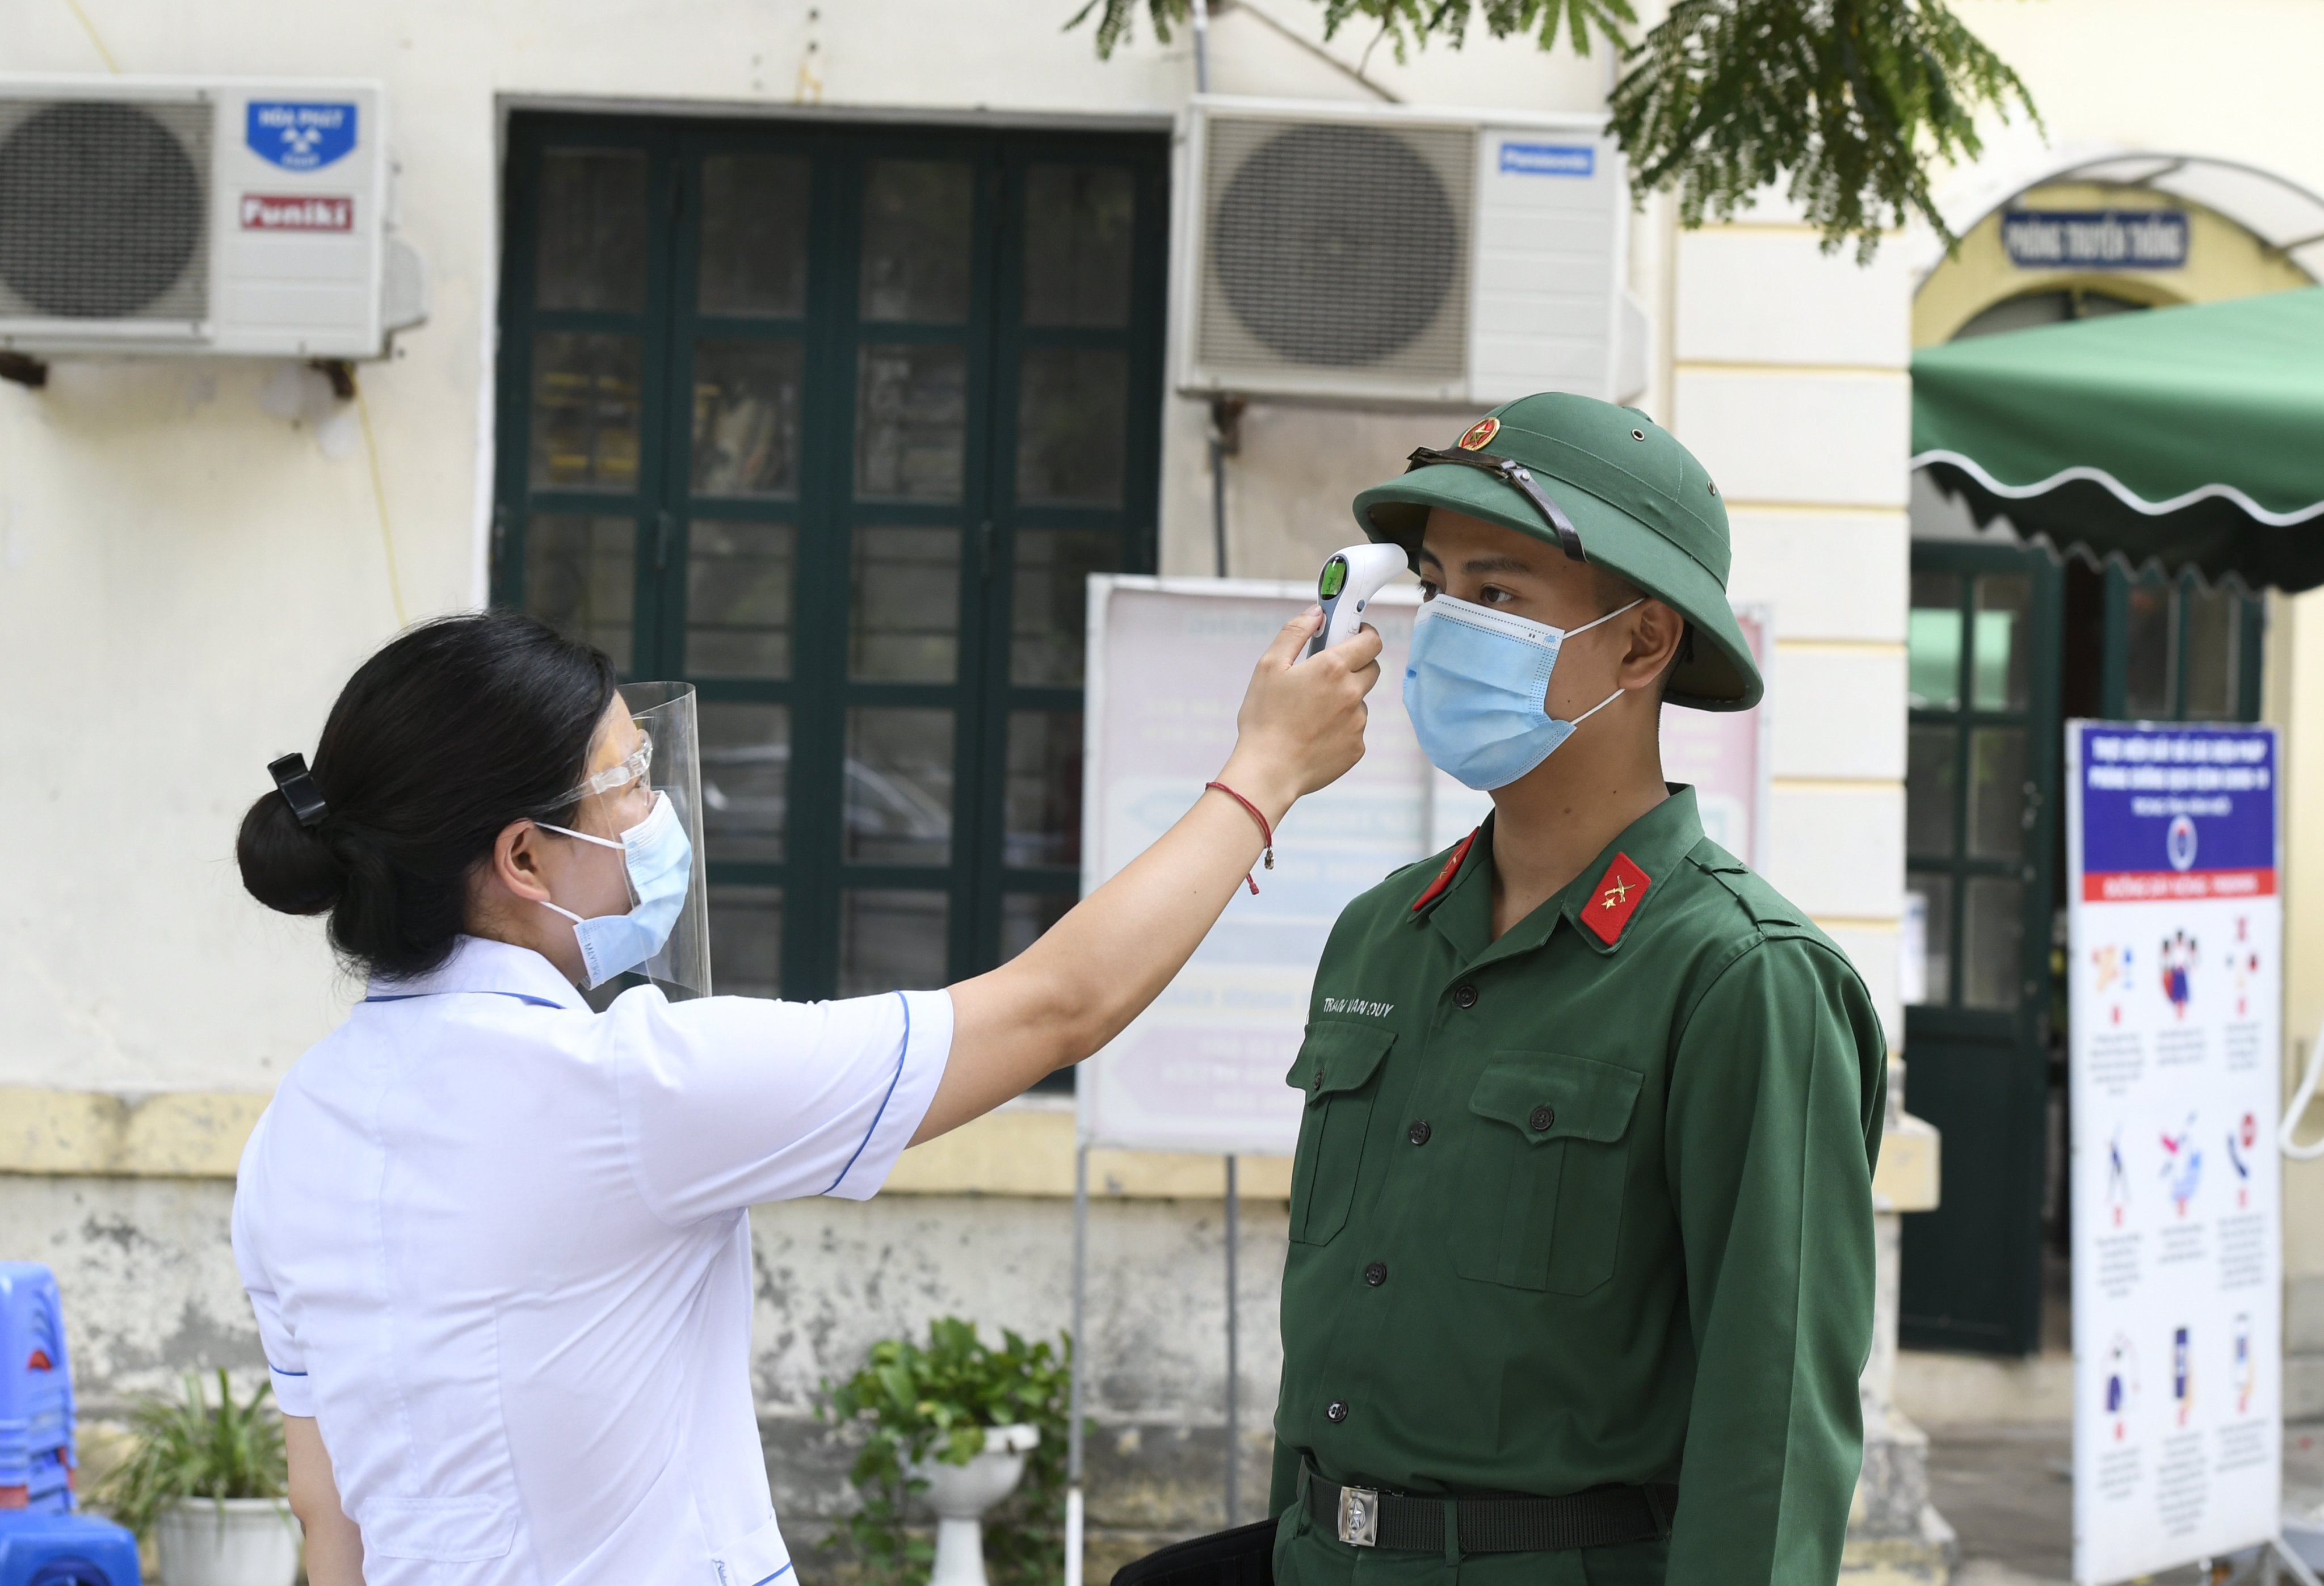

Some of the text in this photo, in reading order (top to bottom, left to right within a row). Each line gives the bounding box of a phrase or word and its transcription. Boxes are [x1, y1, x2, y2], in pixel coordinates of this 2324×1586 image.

[243, 199, 346, 225] Funiki
[1323, 998, 1348, 1013] TRAN
[1346, 998, 1369, 1014] VAN
